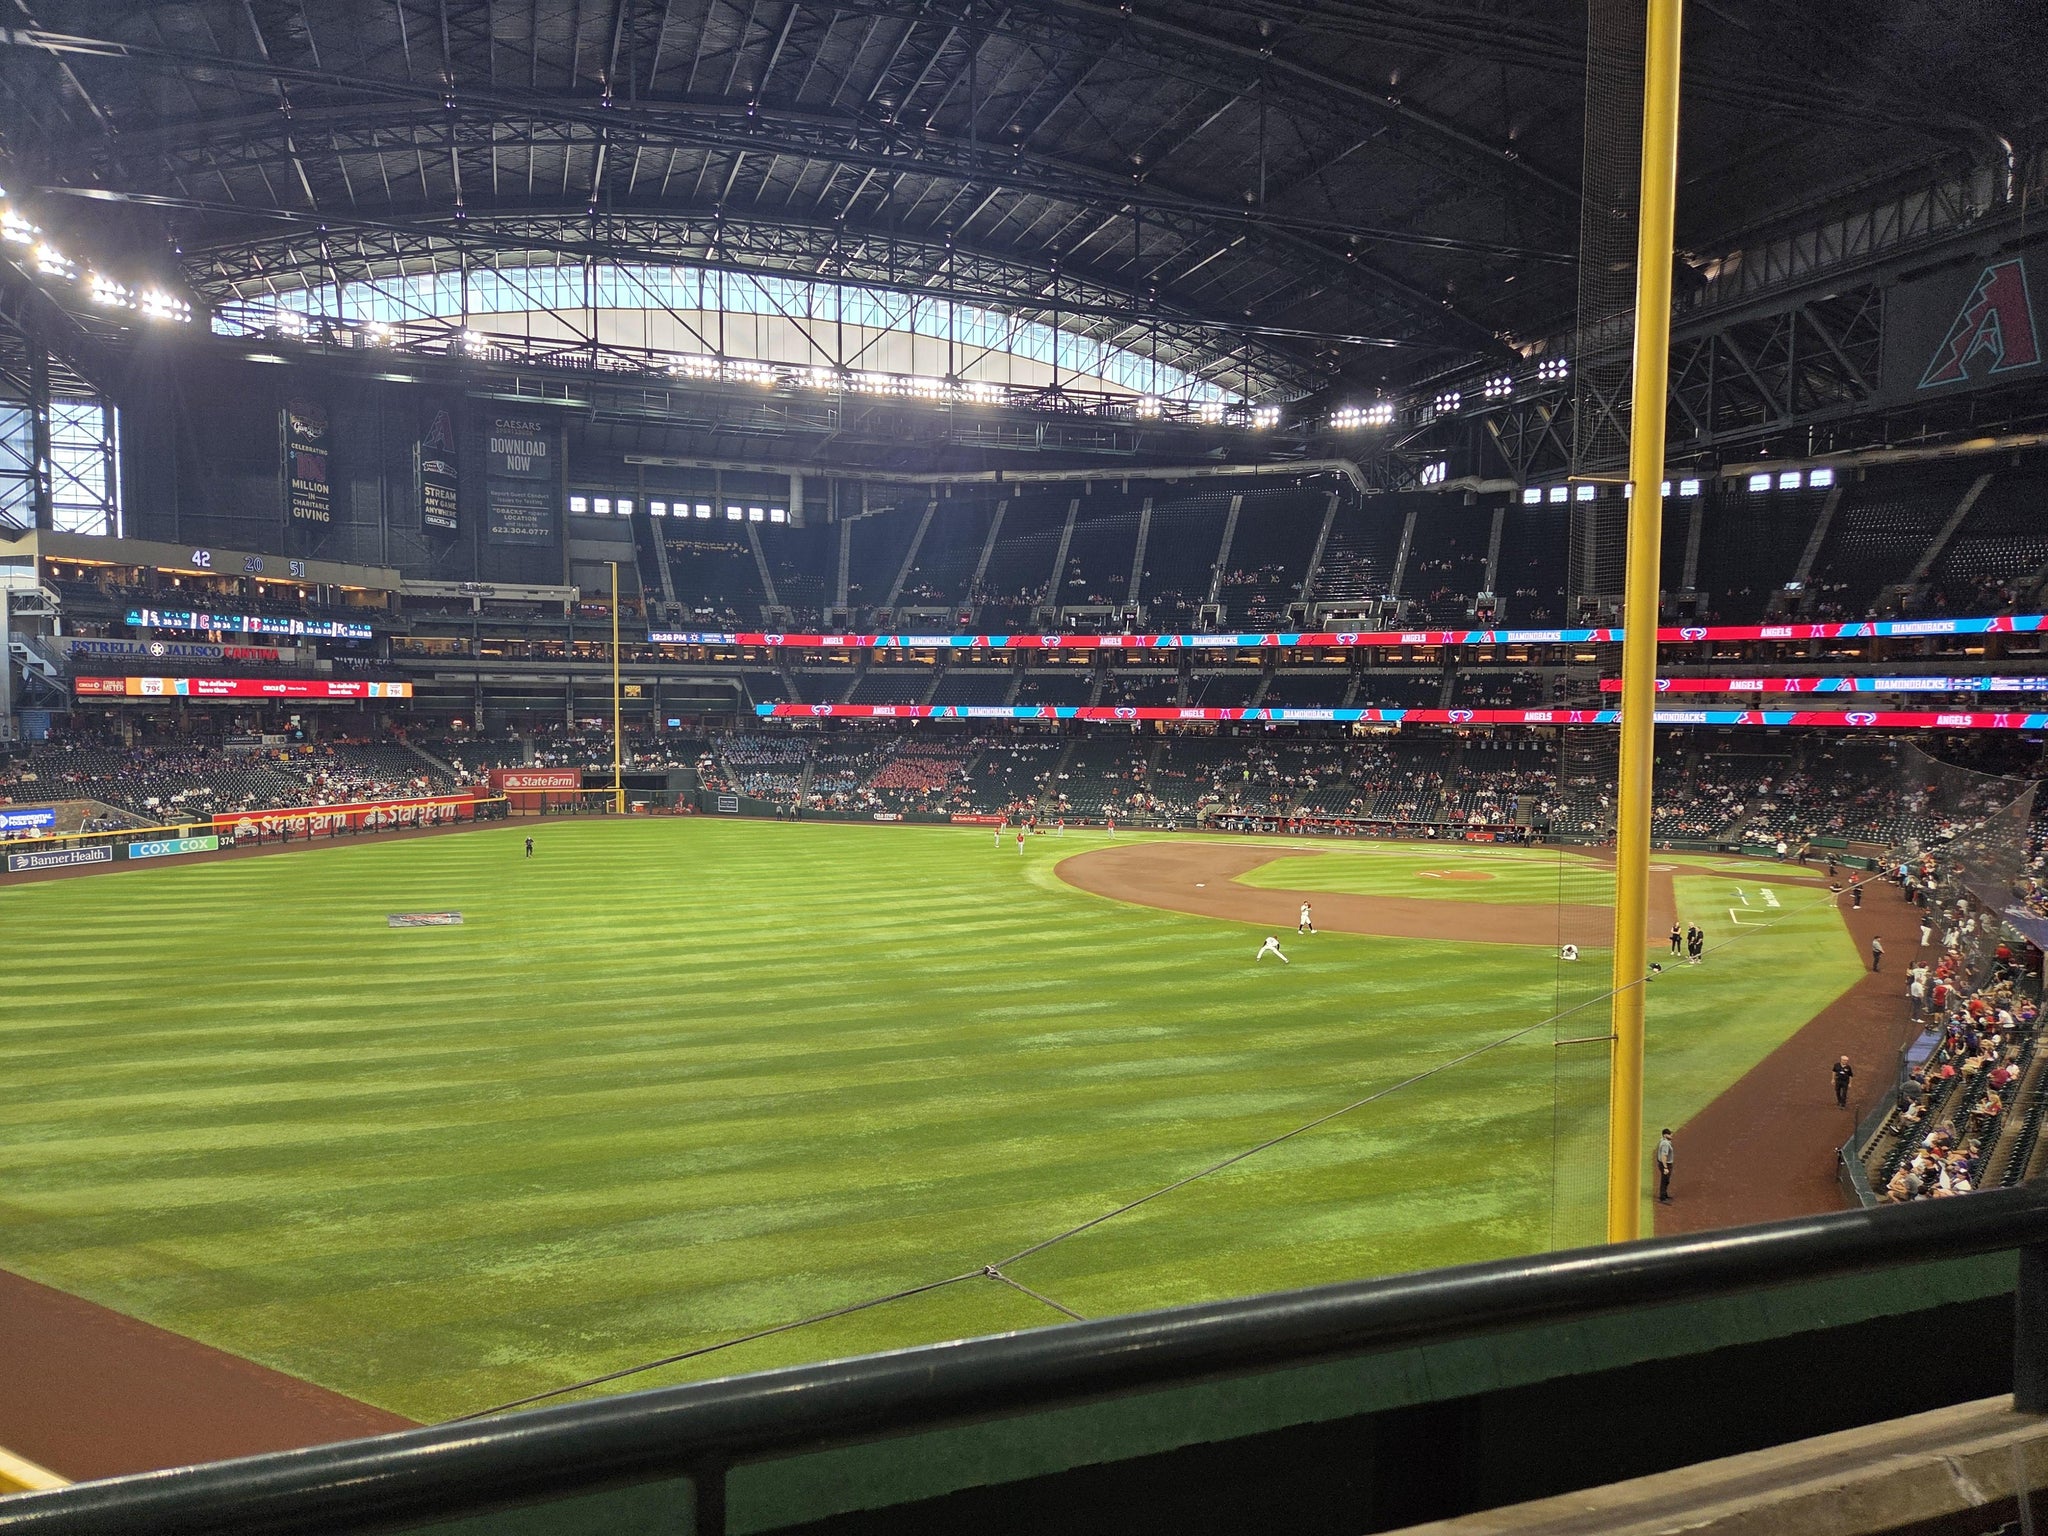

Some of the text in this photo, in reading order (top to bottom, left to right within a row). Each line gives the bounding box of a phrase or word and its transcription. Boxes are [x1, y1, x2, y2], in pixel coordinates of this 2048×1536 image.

[495, 419, 541, 431] CAESARS
[291, 443, 328, 456] CELEBRATING
[490, 438, 546, 456] DOWNLOAD
[507, 455, 530, 471] NOW
[292, 479, 329, 494] MILLION
[425, 486, 456, 501] STREAM
[293, 499, 330, 511] CHARITABLE
[425, 497, 456, 510] ANY GAME
[293, 508, 330, 522] GIVING
[425, 506, 456, 518] ANYWHERE
[492, 527, 549, 535] 623.304.0777
[191, 550, 210, 567] 42
[244, 556, 264, 572] 20
[289, 561, 305, 578] 51
[1760, 627, 1792, 637] ANGELS
[1891, 623, 1954, 633] DIAMONDBACKS
[823, 637, 844, 645] ANGELS
[909, 637, 951, 645] DIAMONDBACKS
[1100, 637, 1122, 645] ANGELS
[1192, 637, 1238, 645] DIAMONDBACKS
[1401, 634, 1426, 642] ANGELS
[1507, 632, 1561, 641] DIAMONDBACKS
[72, 641, 279, 659] ESTRELLA JALISCO CANTINA
[209, 681, 237, 689] definitely
[1729, 680, 1763, 690] ANGELS
[1874, 679, 1945, 690] DIAMONDBACKS
[873, 707, 895, 715] ANGELS
[968, 707, 1014, 716] DIAMONDBACKS
[1180, 710, 1204, 718] ANGELS
[1283, 710, 1334, 719] DIAMONDBACKS
[1524, 712, 1552, 721] ANGELS
[1653, 713, 1706, 722] AMONDBACKS
[1936, 715, 1972, 725] ANGELS
[521, 776, 573, 788] StateFarm
[180, 838, 208, 851] COX
[220, 837, 235, 846] 374
[140, 843, 170, 856] COX
[30, 850, 104, 866] Banner Health
